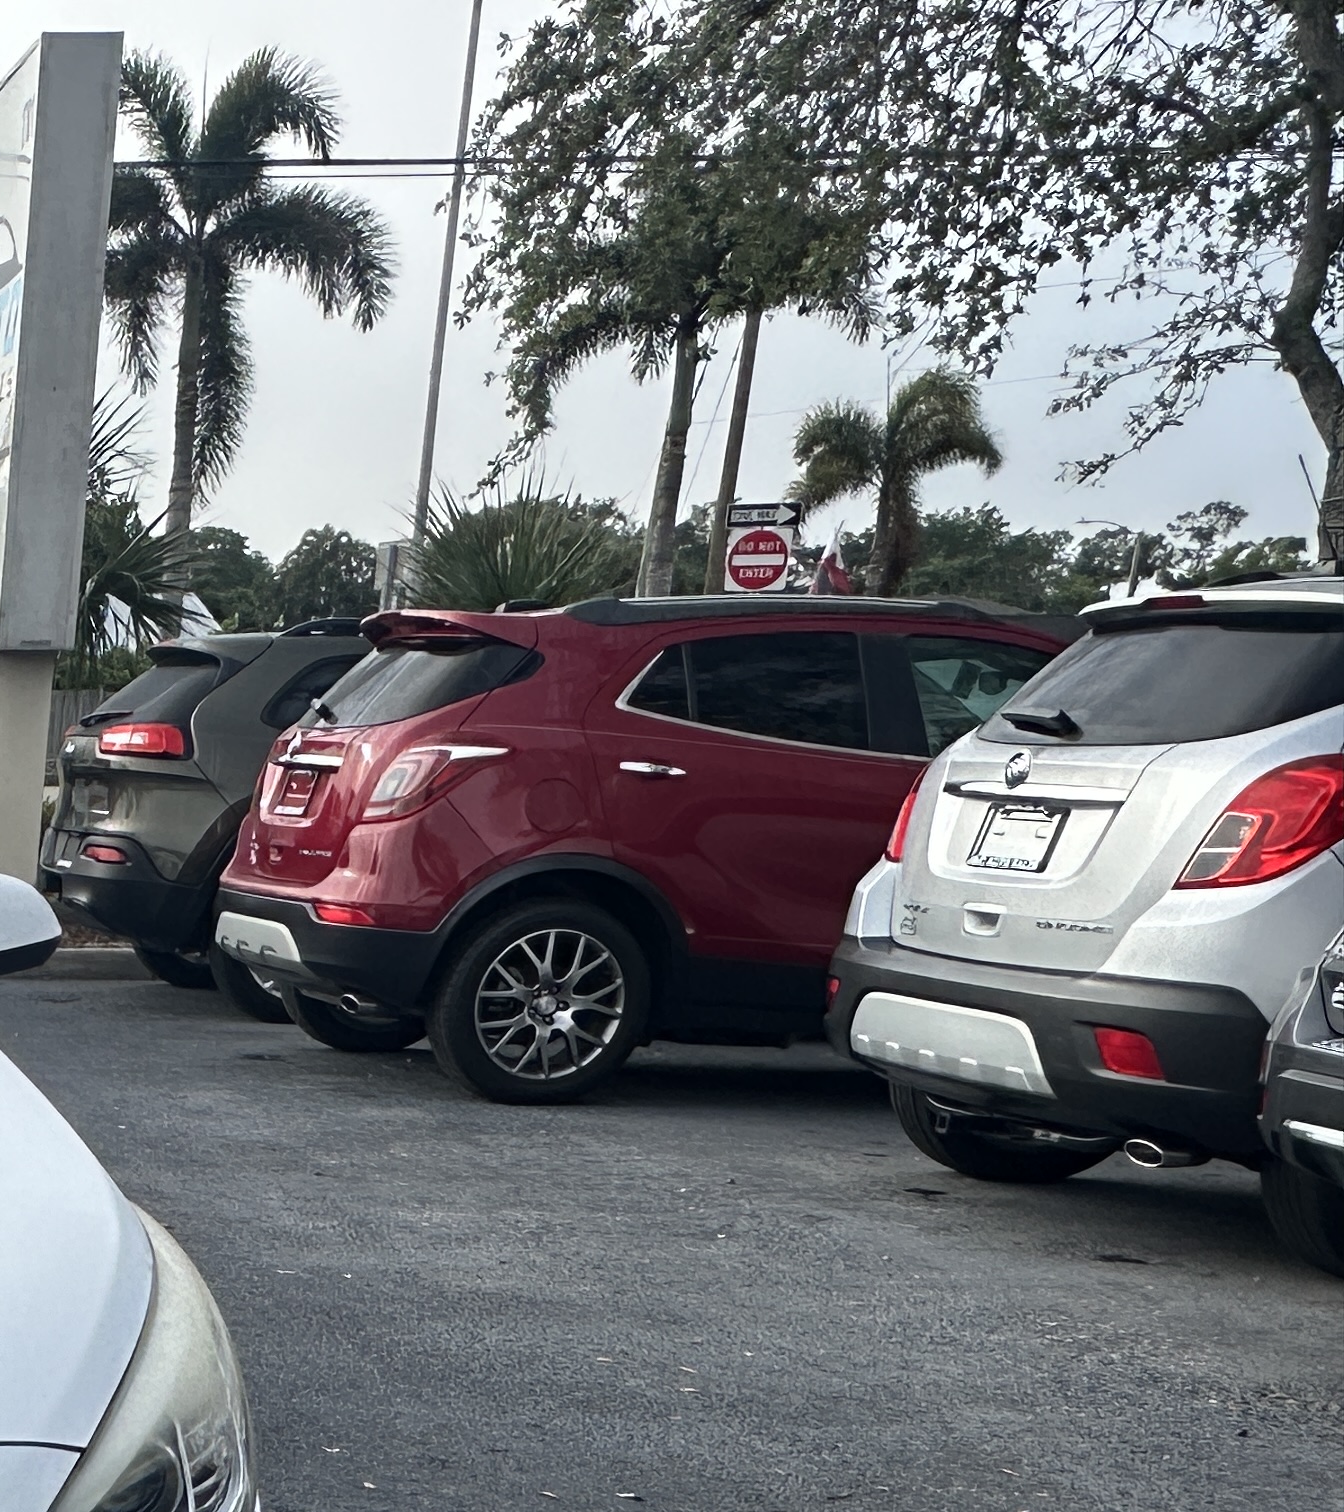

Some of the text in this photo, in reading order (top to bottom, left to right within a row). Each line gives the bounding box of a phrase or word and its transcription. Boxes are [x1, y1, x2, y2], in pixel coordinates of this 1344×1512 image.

[738, 541, 781, 552] DO NOT
[739, 568, 773, 579] ENTER
